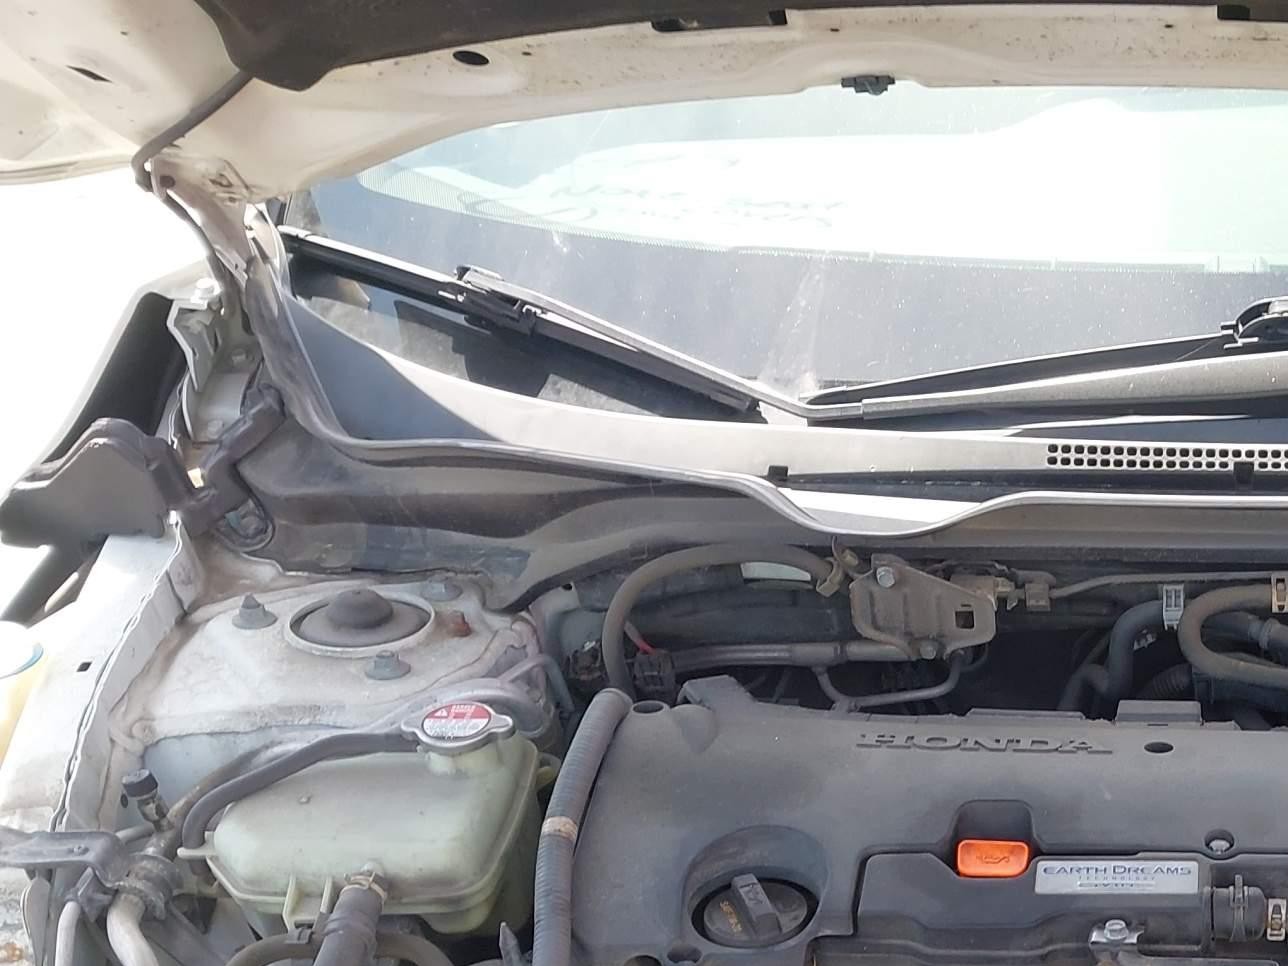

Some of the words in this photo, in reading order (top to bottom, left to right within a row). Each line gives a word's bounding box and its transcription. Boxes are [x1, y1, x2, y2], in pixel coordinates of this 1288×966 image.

[856, 733, 1113, 754] HONDA
[1042, 865, 1107, 875] EARTH
[1112, 865, 1192, 876] DREAMS
